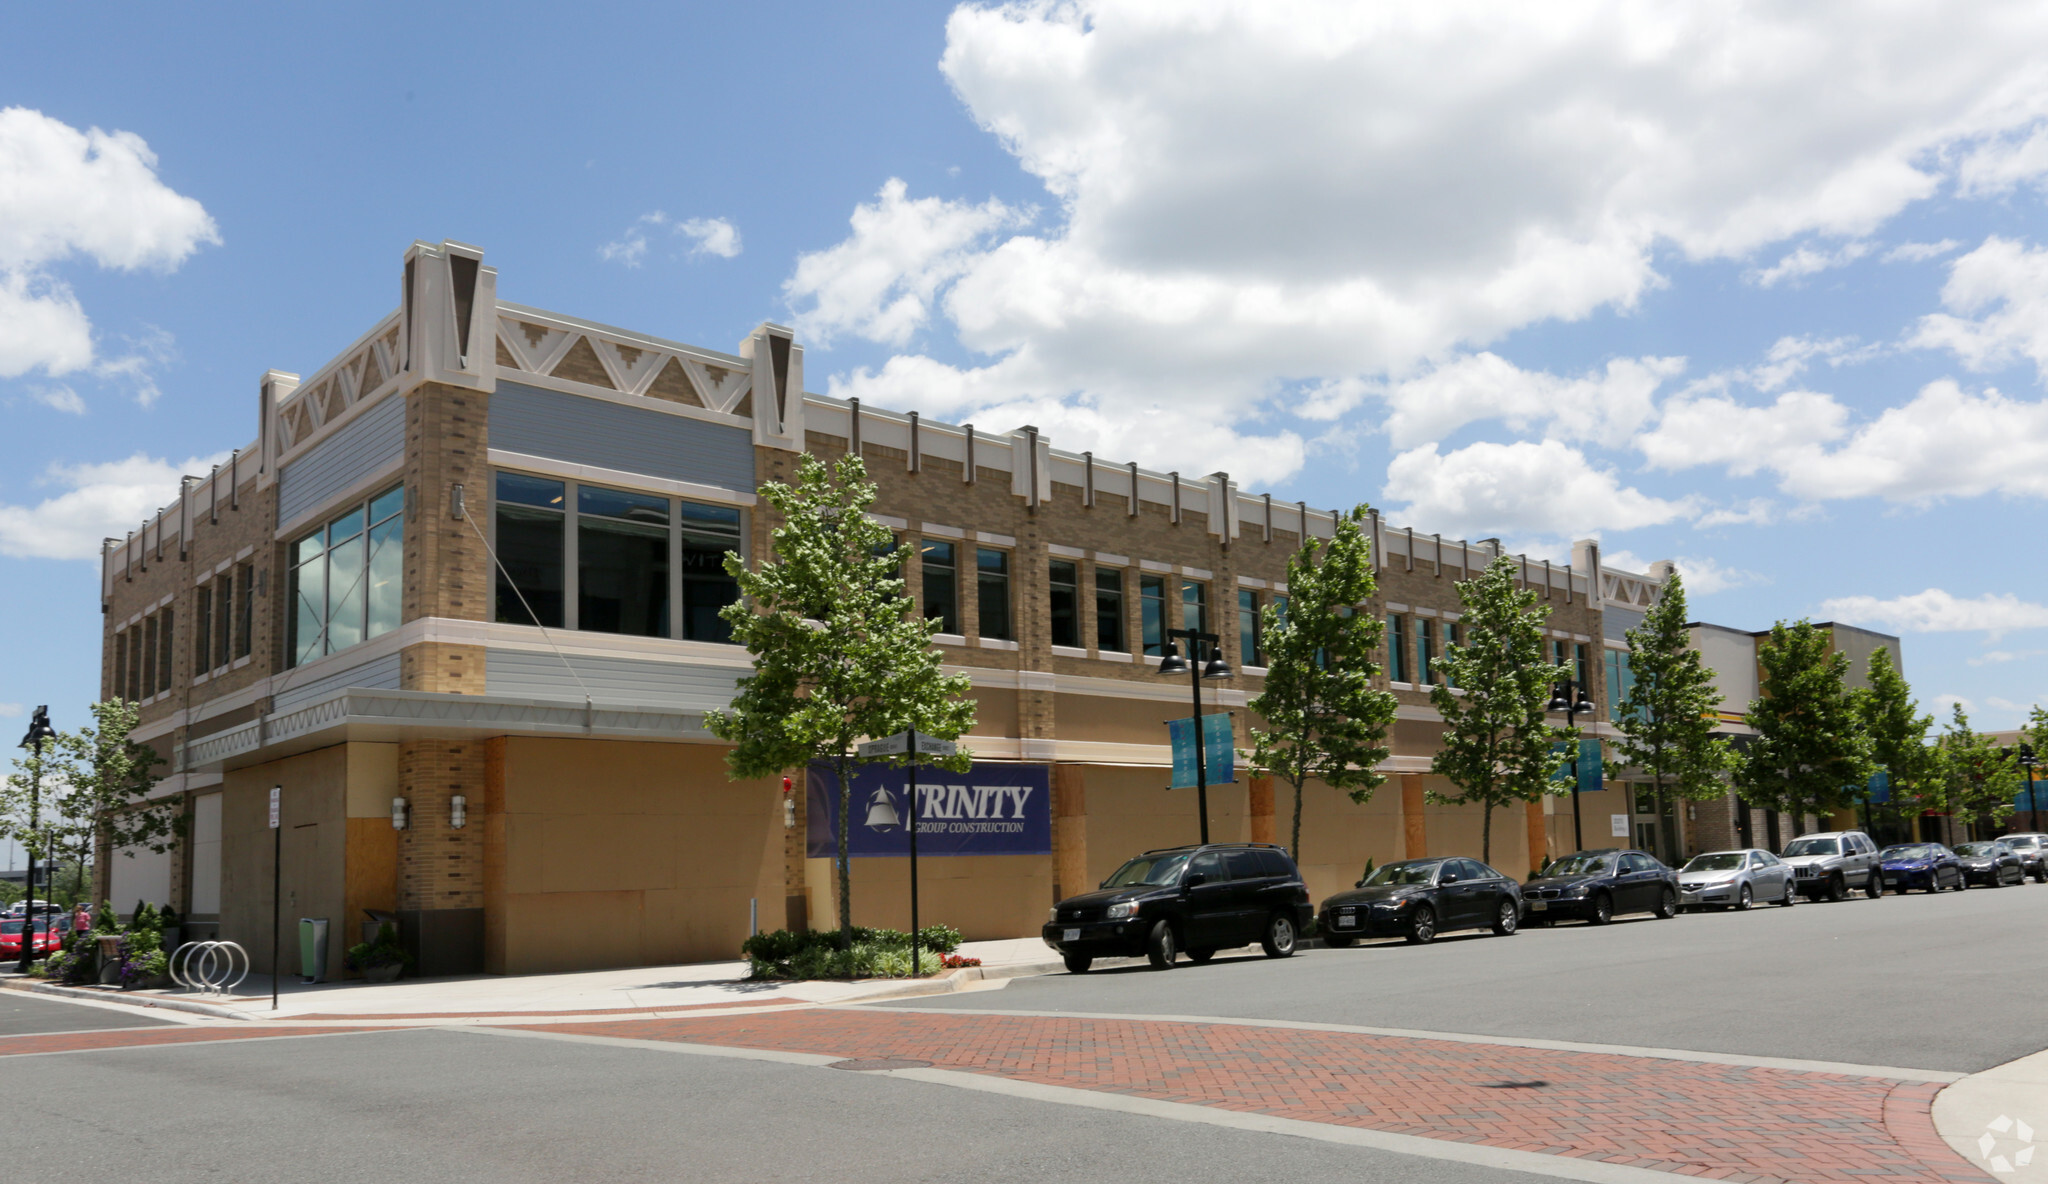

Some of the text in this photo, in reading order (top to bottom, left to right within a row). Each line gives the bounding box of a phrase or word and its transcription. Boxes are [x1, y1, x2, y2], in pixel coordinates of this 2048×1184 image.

[903, 784, 1033, 831] TRINITY
[915, 821, 1025, 833] GROUP CONSTRUCTION
